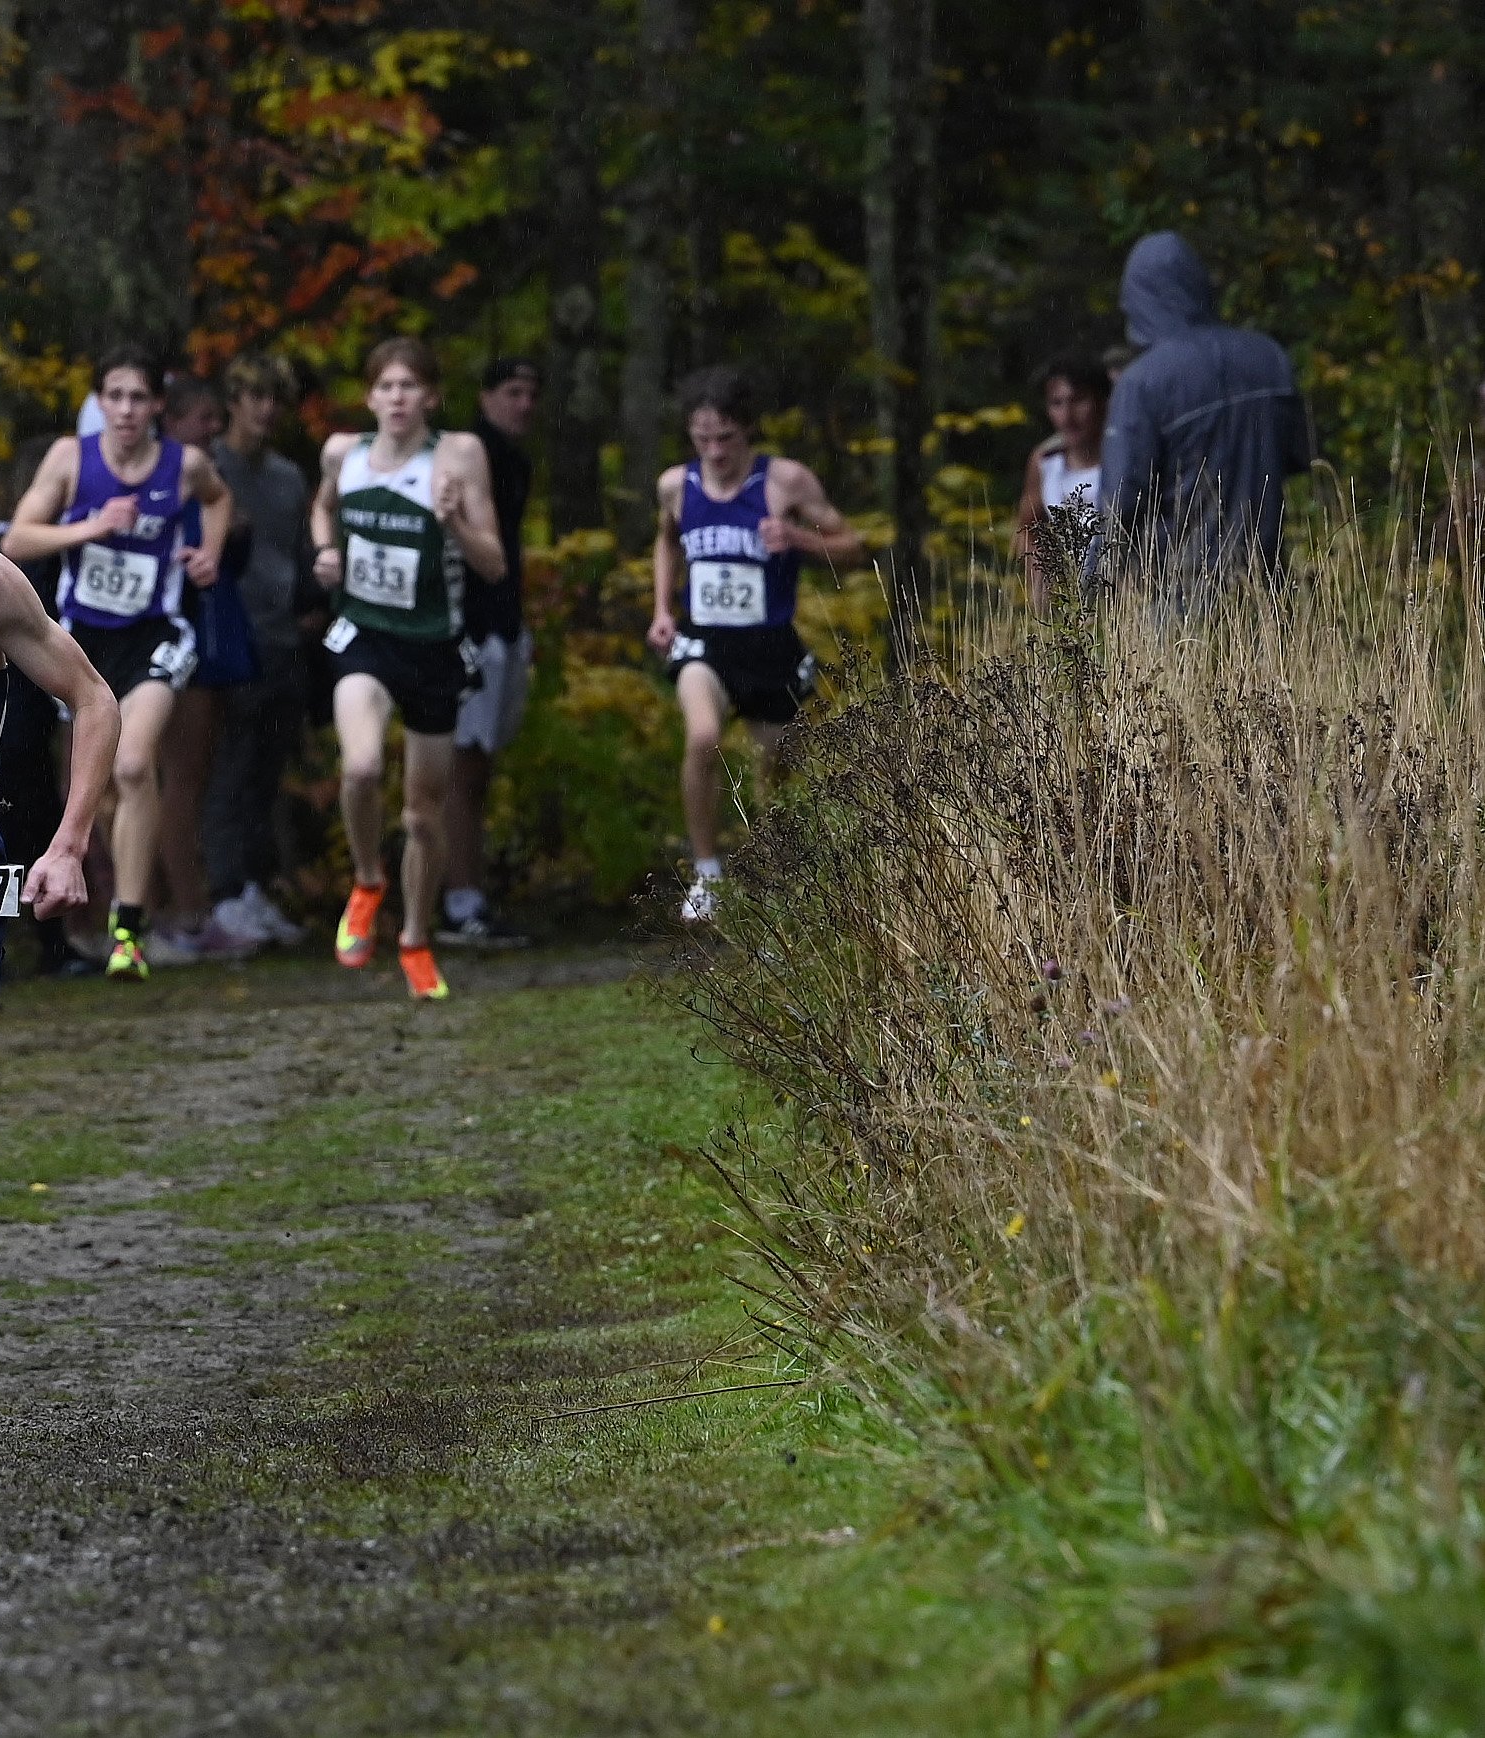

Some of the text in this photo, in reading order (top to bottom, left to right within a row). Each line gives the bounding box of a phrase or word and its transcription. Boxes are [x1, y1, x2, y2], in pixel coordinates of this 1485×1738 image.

[86, 564, 142, 600] 697
[352, 557, 406, 594] 633
[700, 581, 753, 610] 662
